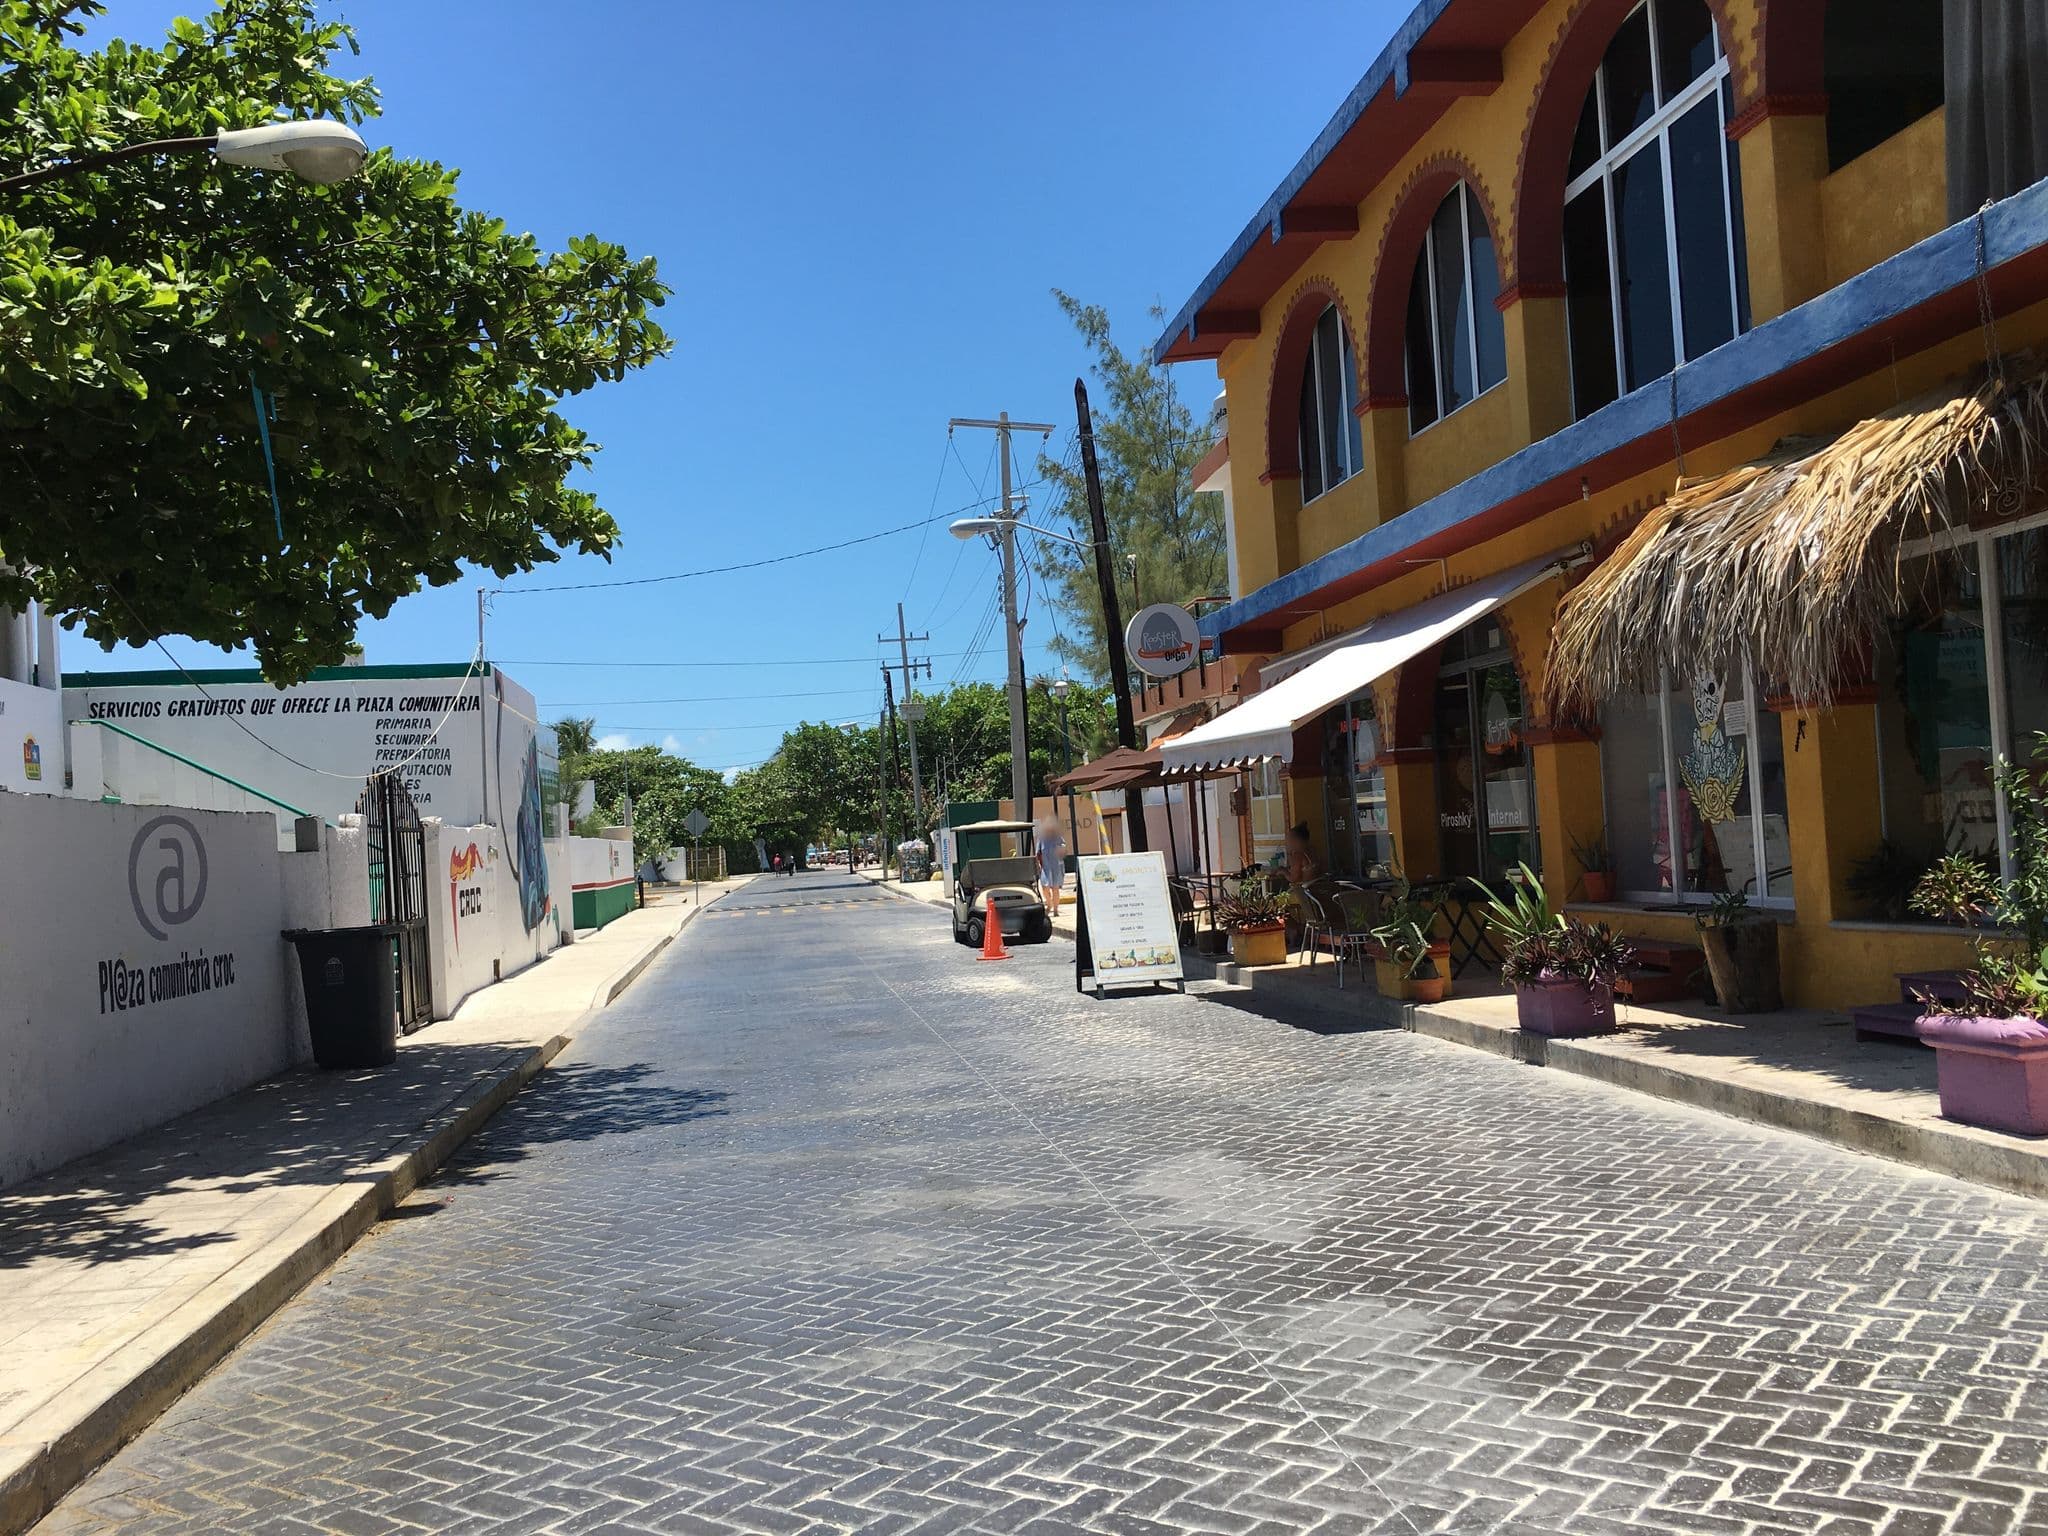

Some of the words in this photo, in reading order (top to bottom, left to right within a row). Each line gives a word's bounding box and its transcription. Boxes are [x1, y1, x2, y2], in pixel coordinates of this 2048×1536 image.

[88, 701, 161, 718] SERVICIOS
[168, 699, 246, 716] GRATUITOS
[251, 698, 276, 715] QUE
[282, 697, 331, 714] OFRECE
[334, 697, 350, 713] LA
[357, 696, 394, 712] PLAZA
[399, 695, 480, 712] COMUNITARIA
[376, 718, 431, 729] PRIMARIA
[375, 734, 437, 745] SECUNDARIA
[376, 748, 451, 760] PREPARATORIA
[1440, 812, 1472, 828] Piroshky
[459, 887, 481, 917] CROC
[99, 958, 145, 1014] Pl@za
[149, 948, 211, 1003] comunitaria
[213, 953, 235, 988] croc
